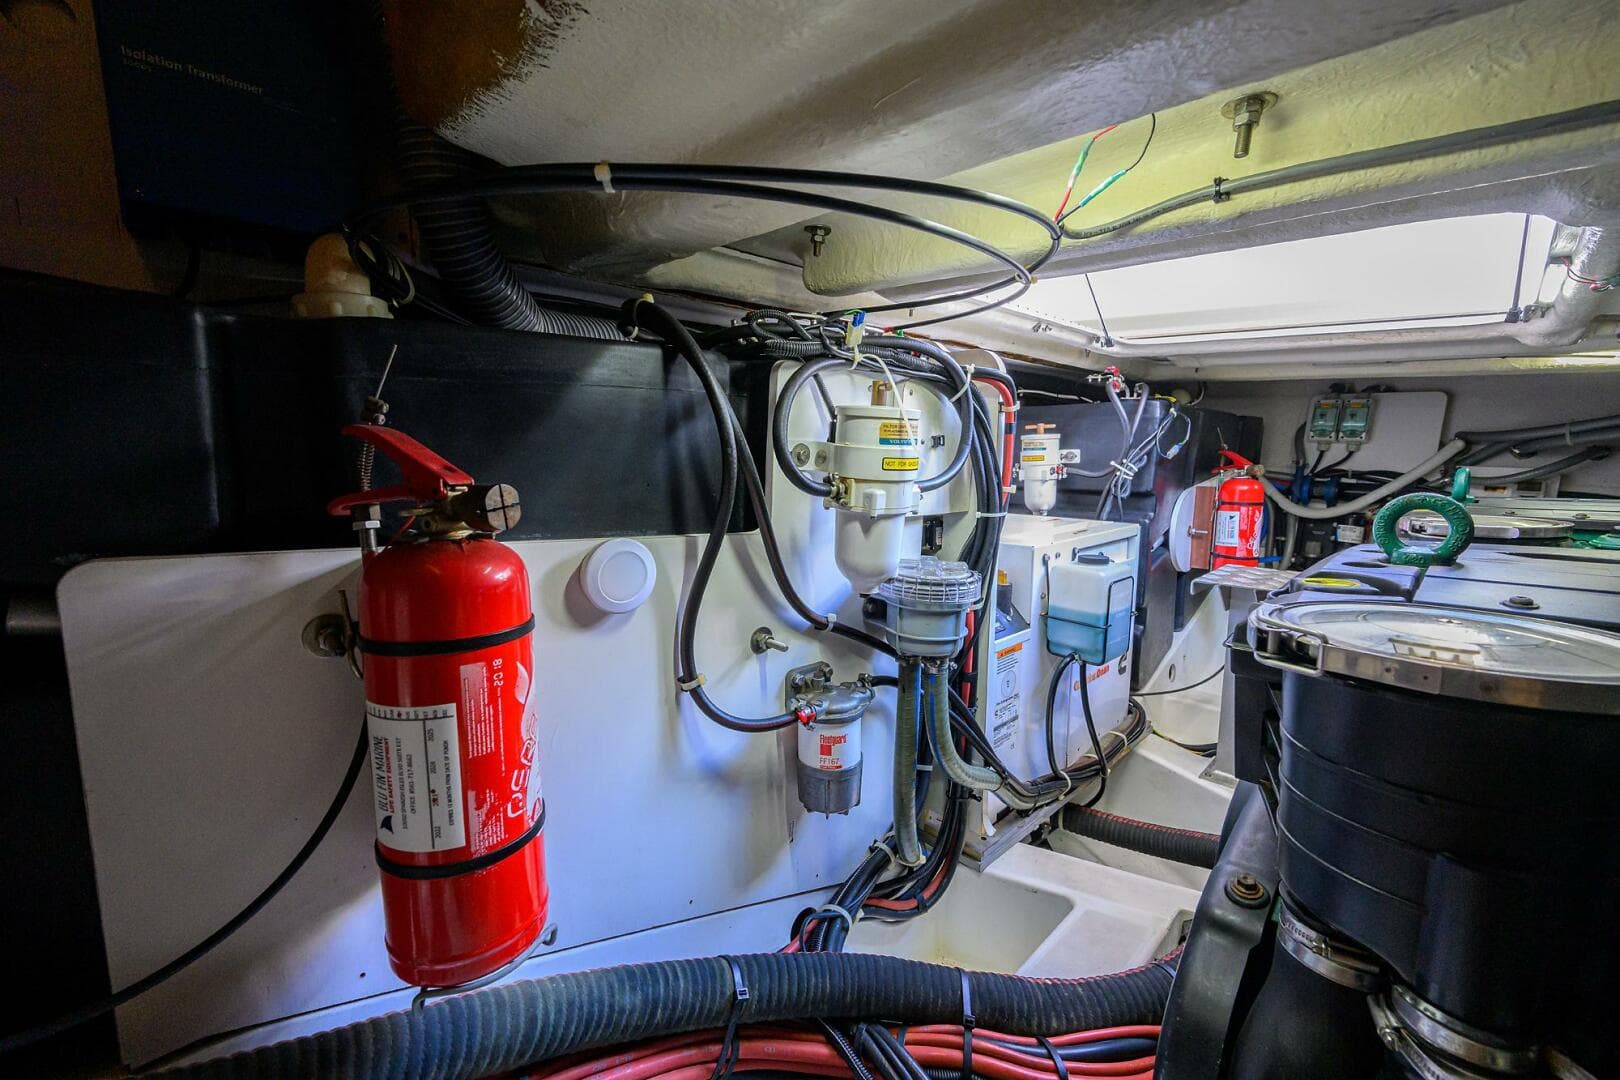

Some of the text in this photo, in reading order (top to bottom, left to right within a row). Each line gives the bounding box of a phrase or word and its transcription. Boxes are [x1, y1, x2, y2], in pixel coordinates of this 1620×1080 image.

[121, 44, 183, 71] Isolation
[186, 63, 264, 95] Transformer
[373, 736, 389, 812] BLU FIN MARINE
[384, 737, 392, 774] EQUIPMENT
[386, 775, 394, 798] SAFETY
